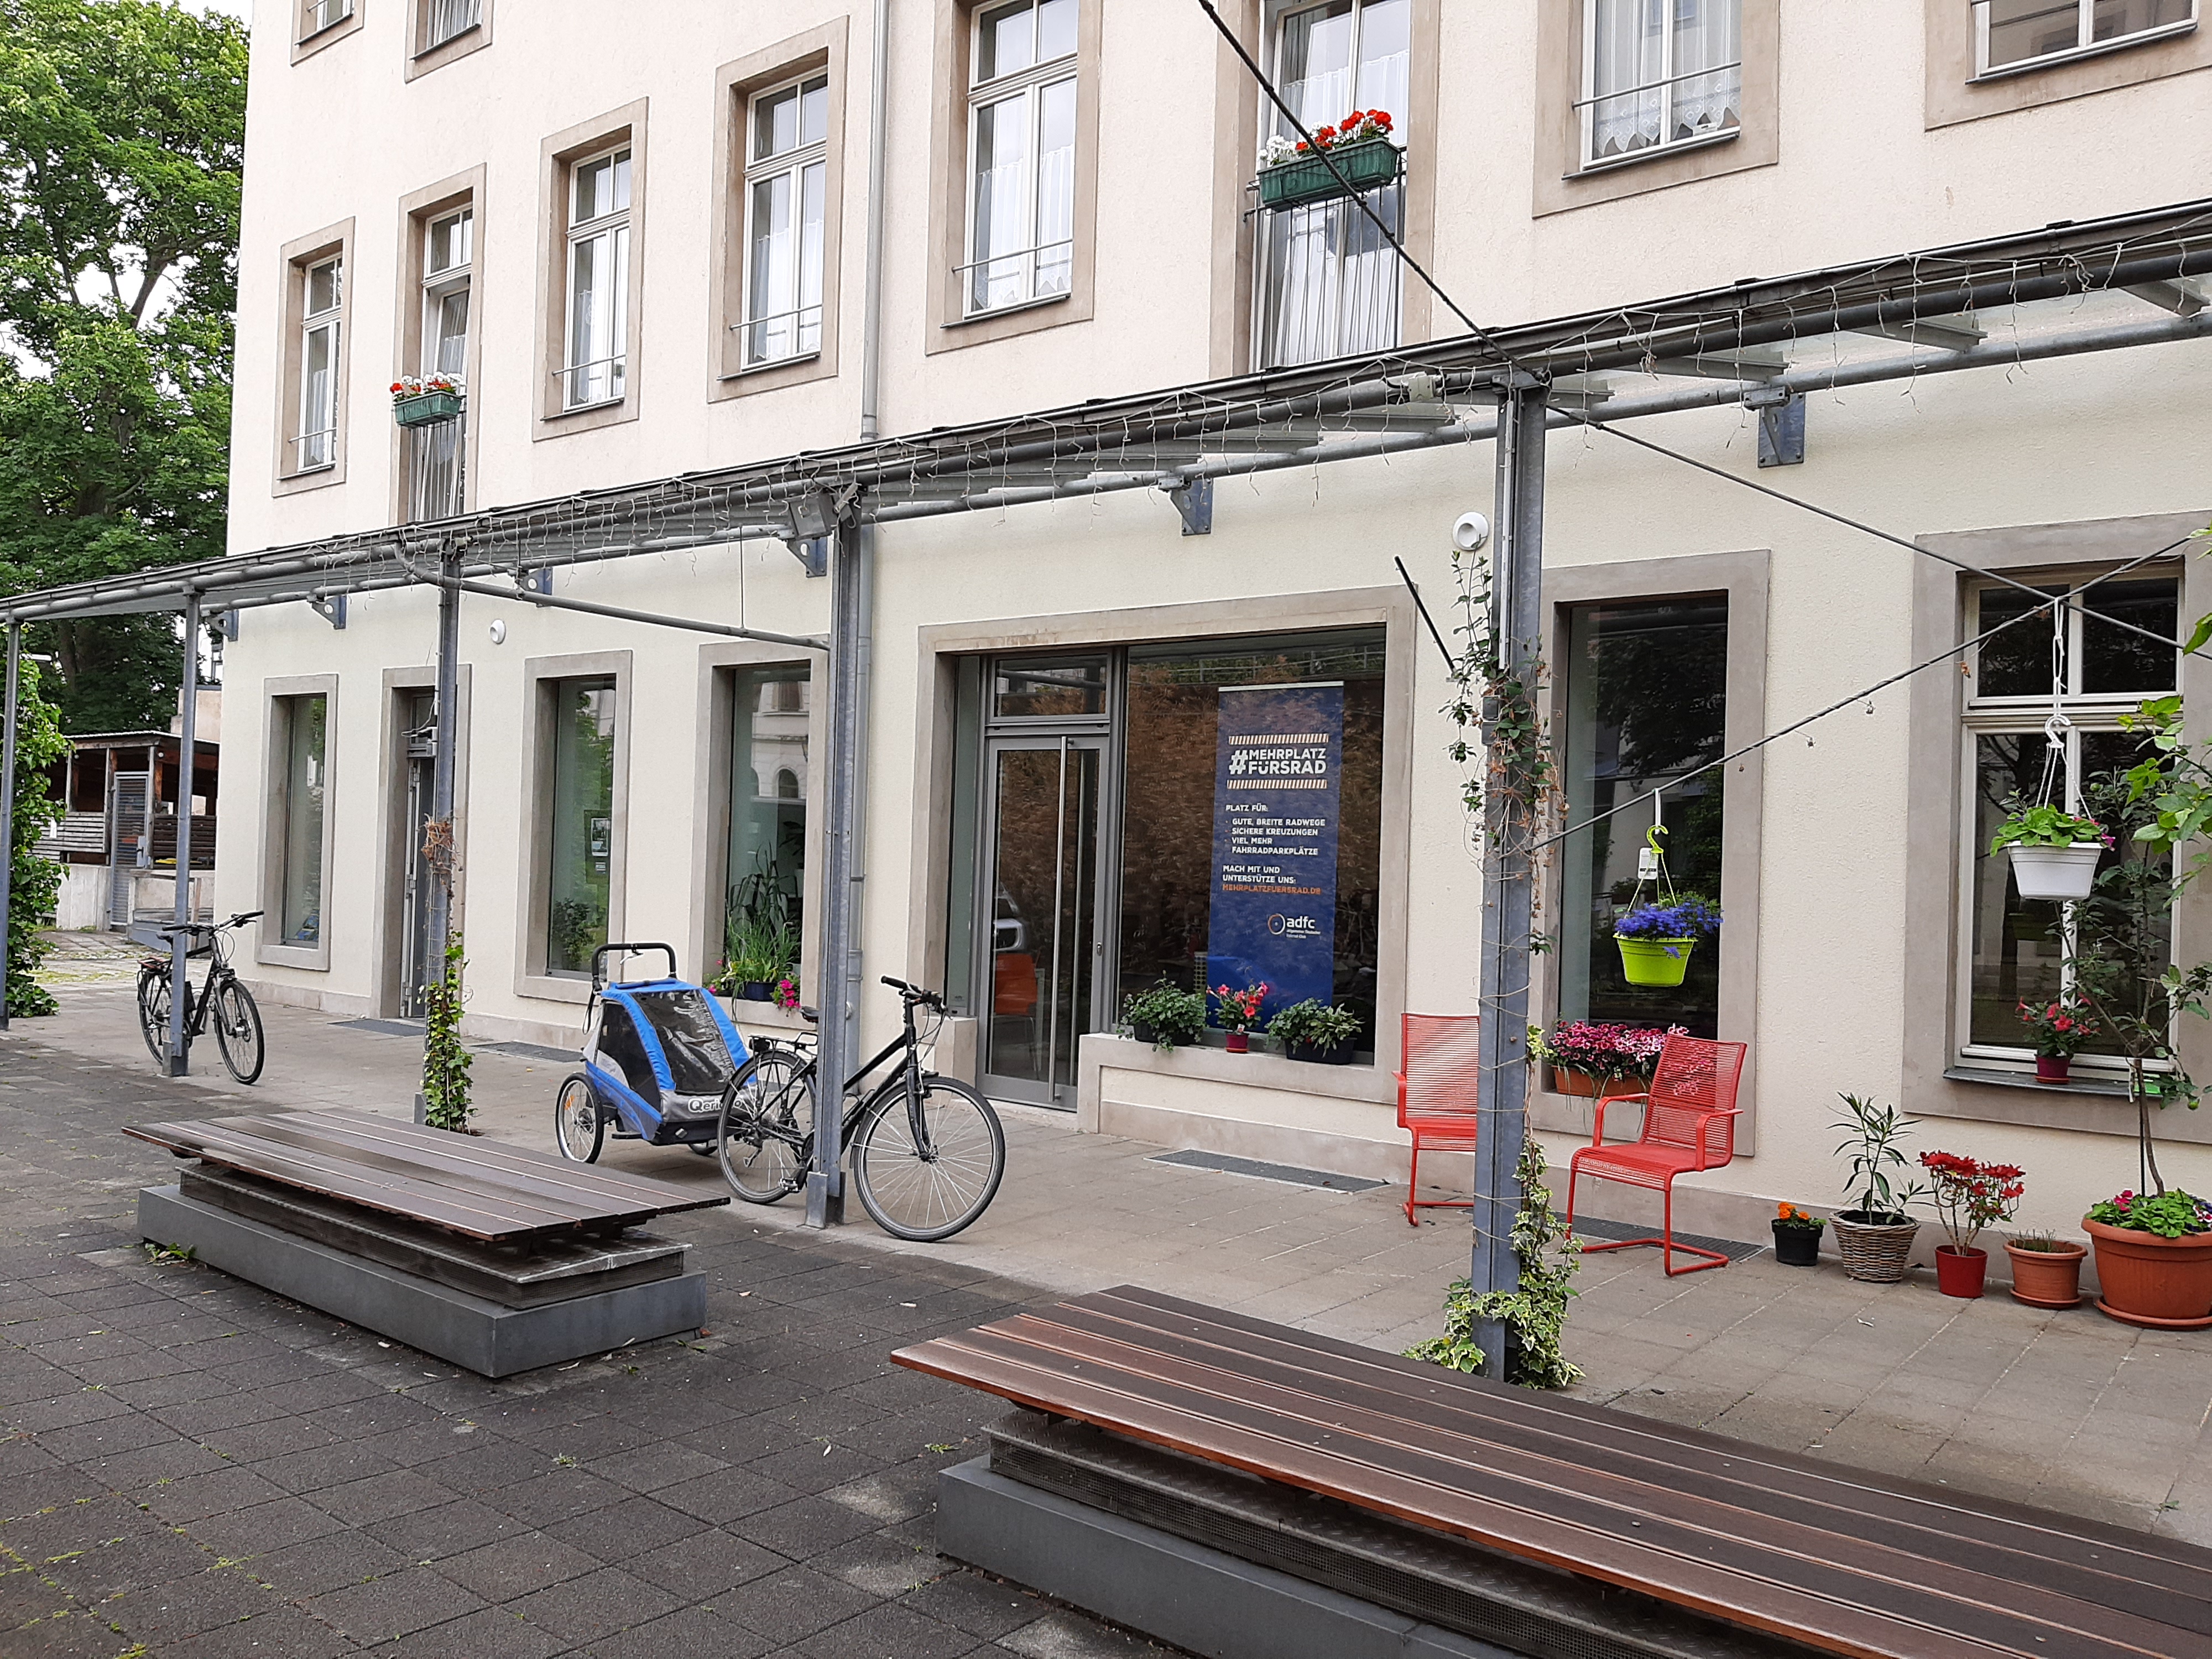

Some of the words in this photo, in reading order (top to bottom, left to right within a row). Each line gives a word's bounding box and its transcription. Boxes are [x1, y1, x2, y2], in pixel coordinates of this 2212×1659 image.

[1248, 760, 1326, 774] FÜRSRAD
[1232, 846, 1318, 855] FAHRRADPARKPLÄTZE
[1222, 874, 1275, 883] UNTERSTÜTZE
[1286, 916, 1316, 929] adfc
